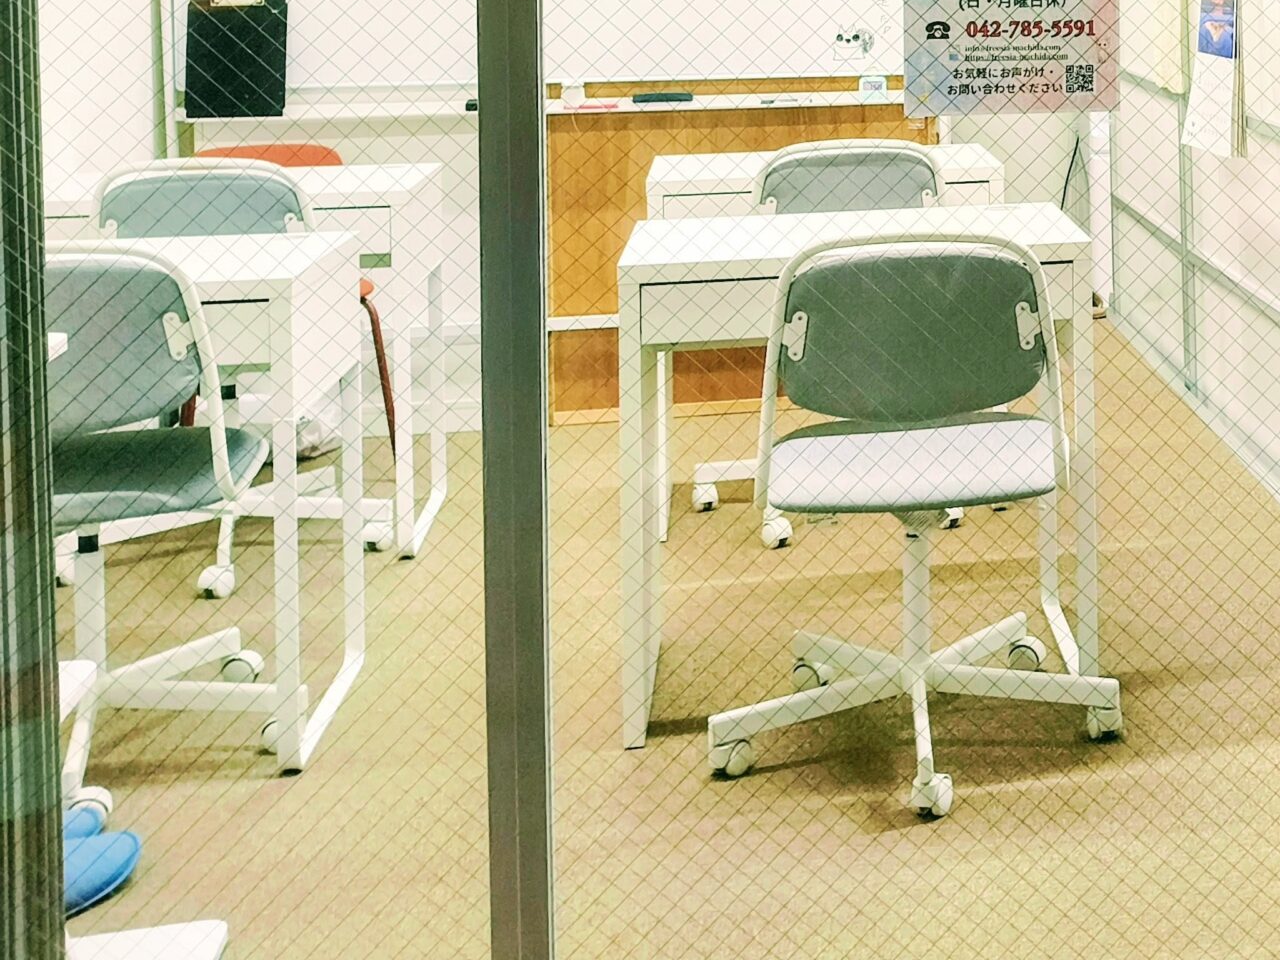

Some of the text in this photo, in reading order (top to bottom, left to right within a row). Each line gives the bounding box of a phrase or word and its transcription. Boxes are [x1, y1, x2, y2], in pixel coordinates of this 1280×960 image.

[965, 20, 1096, 38] 042-785-5591
[947, 82, 1063, 95] お問い合わせください
